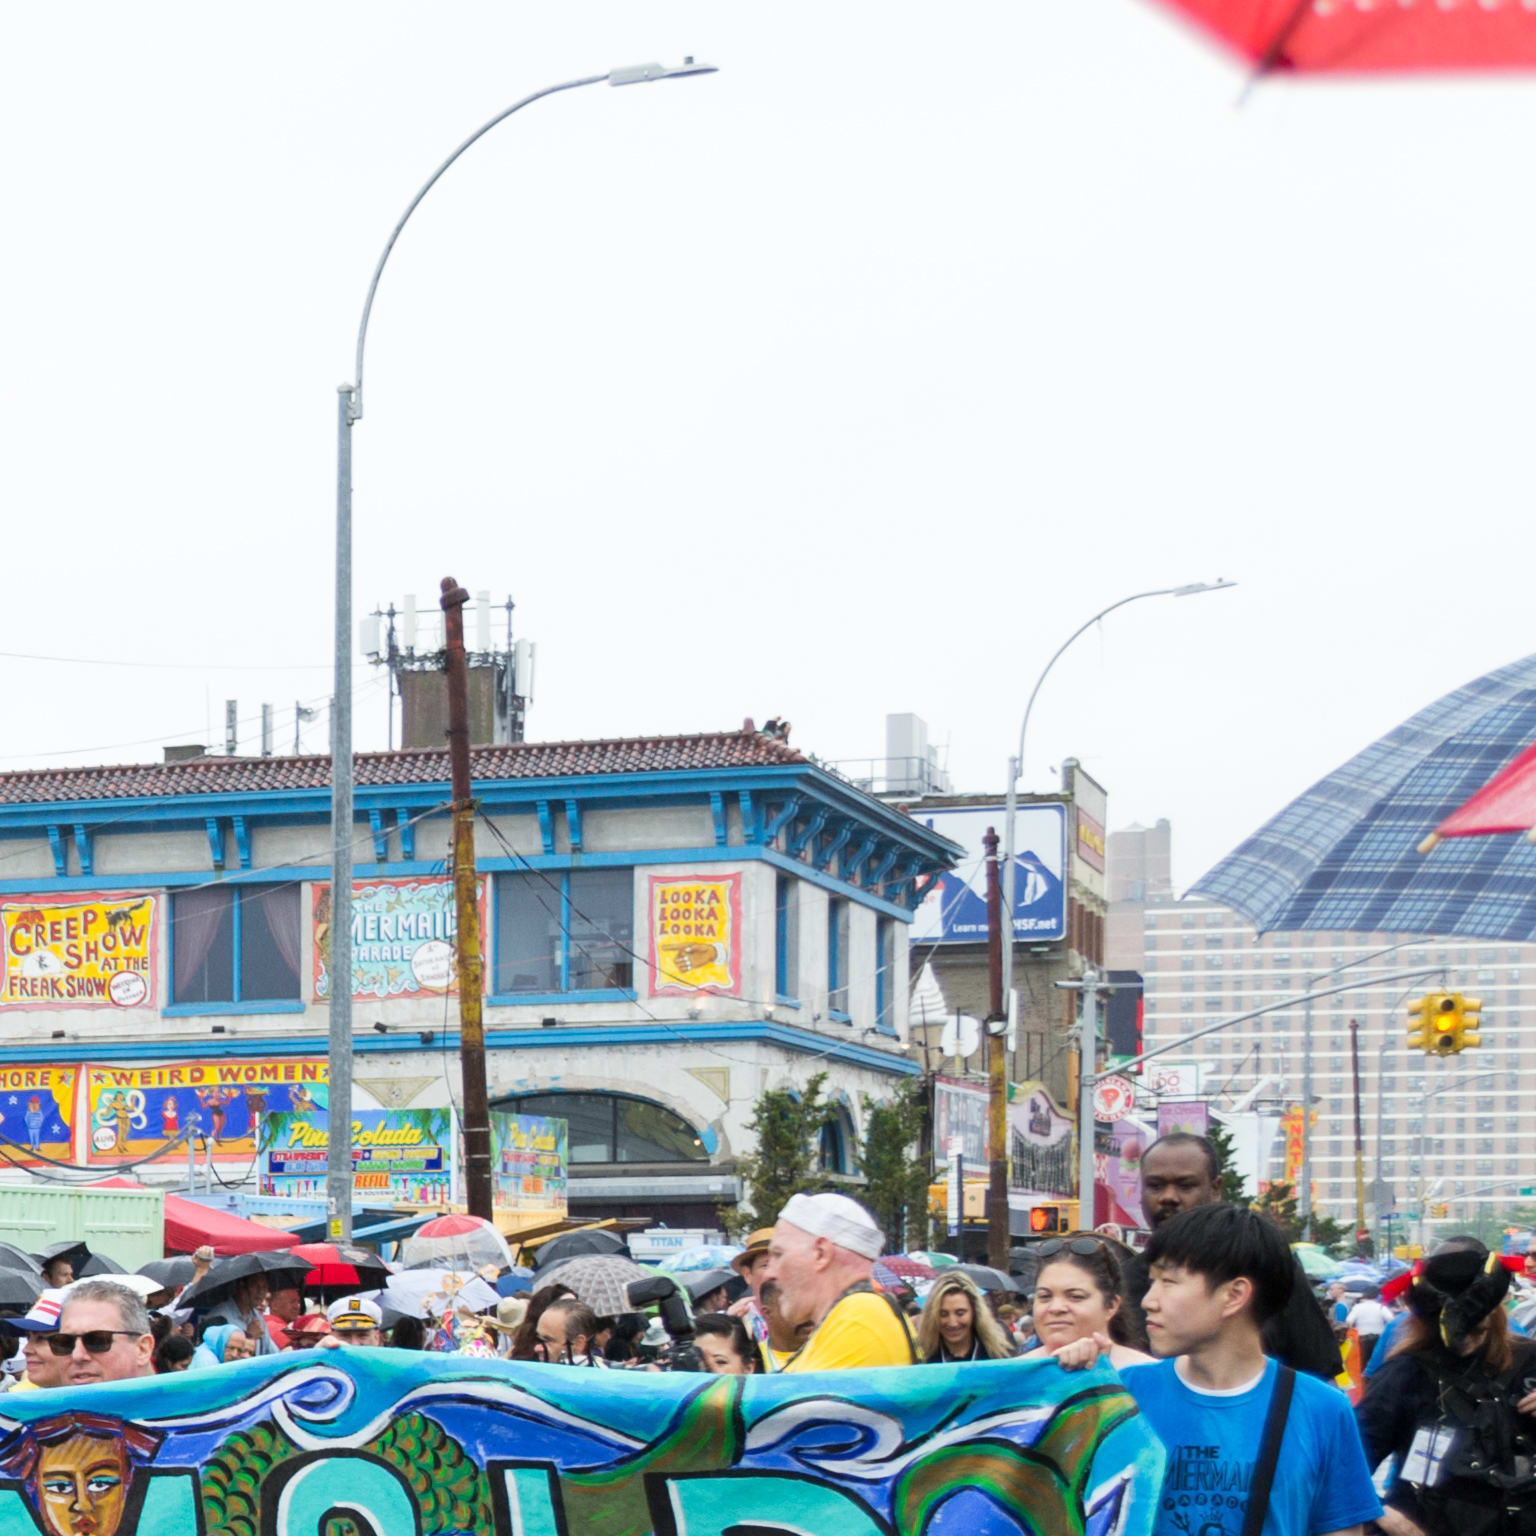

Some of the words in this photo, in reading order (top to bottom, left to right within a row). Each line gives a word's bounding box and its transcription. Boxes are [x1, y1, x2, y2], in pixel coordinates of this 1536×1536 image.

[659, 889, 721, 905] LOOKA
[354, 903, 384, 913] THE
[659, 907, 719, 921] LOOKA
[9, 909, 98, 956] CREEP
[659, 923, 717, 937] LOOKA
[63, 925, 146, 969] SHOW
[101, 956, 120, 971] AT
[124, 956, 148, 970] THE
[9, 976, 64, 998] FREAK
[65, 975, 107, 998] SHOW
[110, 1067, 205, 1086] WEIRD
[218, 1064, 318, 1082] WOMEN
[353, 1174, 390, 1189] REFILL
[650, 1236, 684, 1247] TITAN
[1184, 1445, 1220, 1459] THE
[1165, 1460, 1256, 1492] MERMAI
[1162, 1493, 1249, 1511] PARAD
